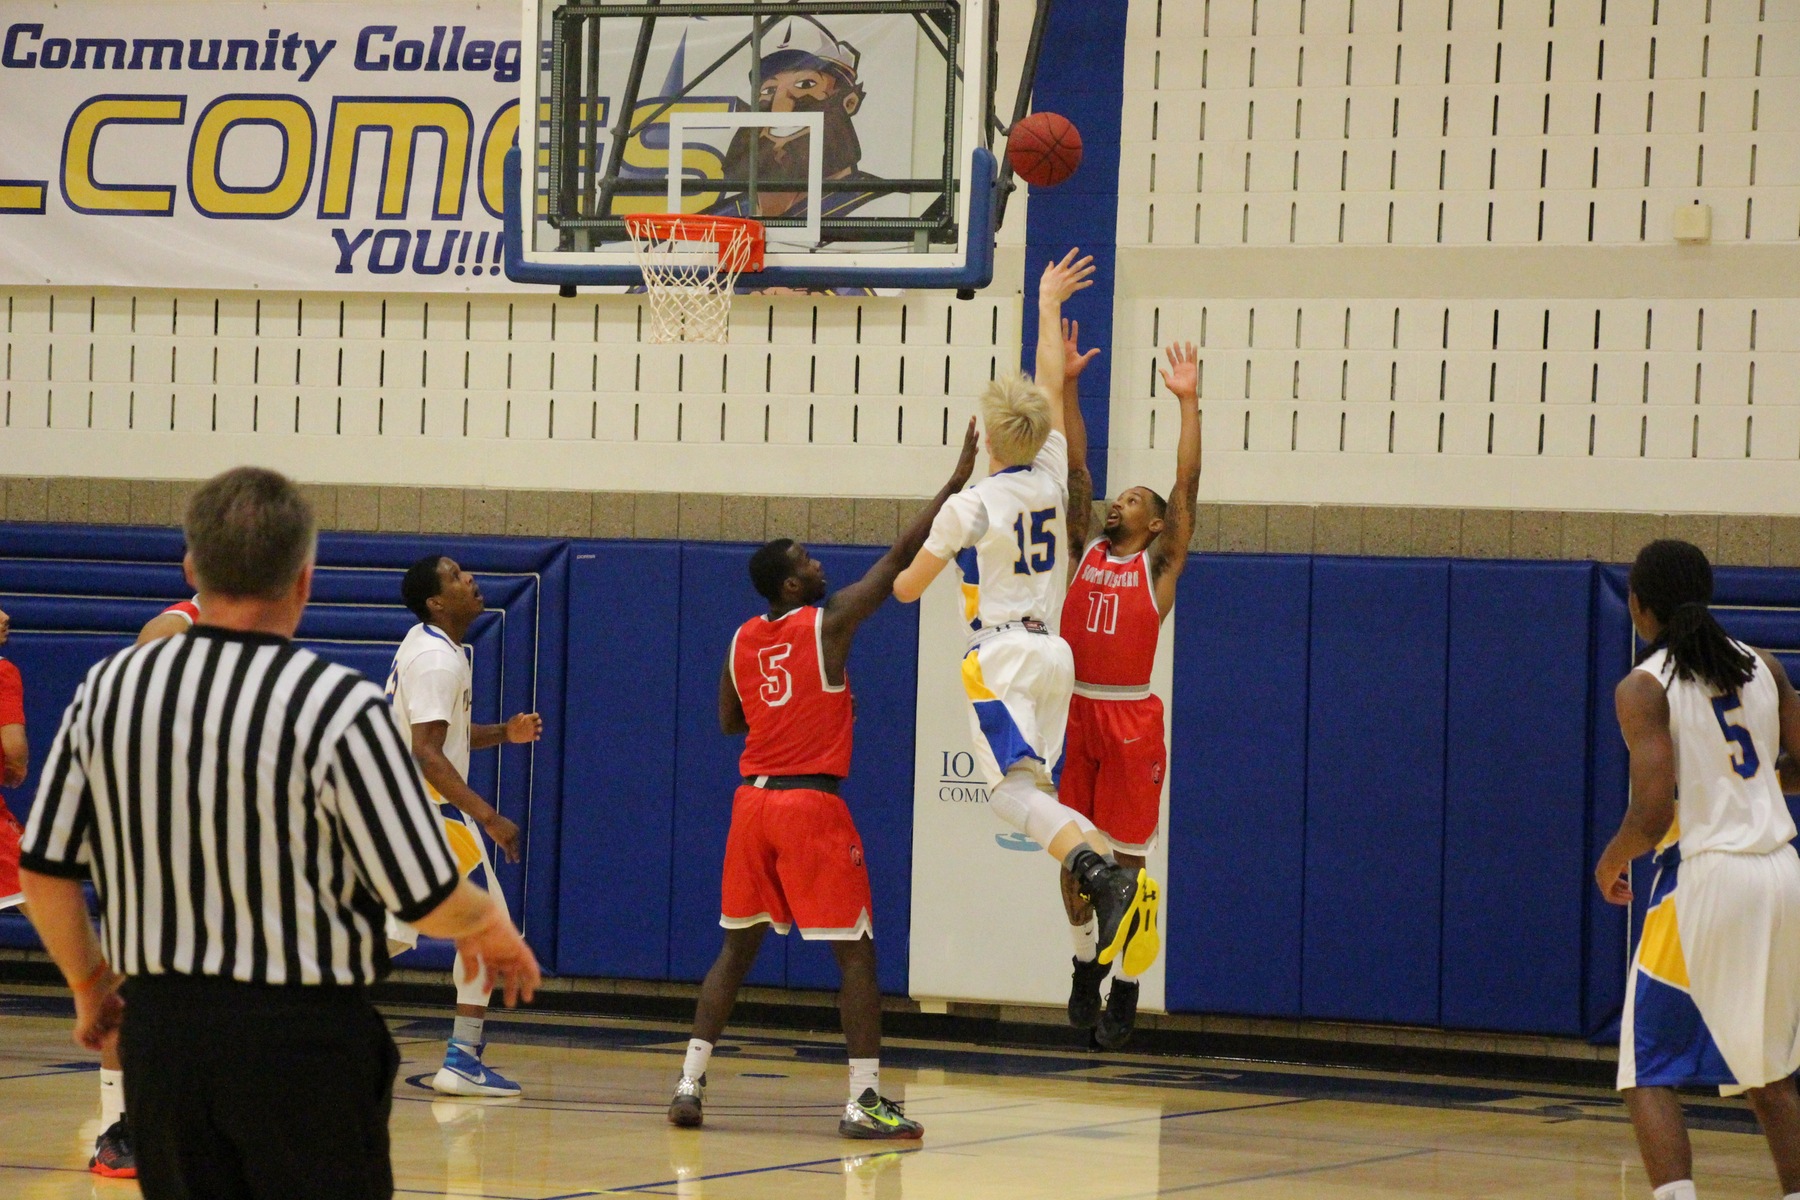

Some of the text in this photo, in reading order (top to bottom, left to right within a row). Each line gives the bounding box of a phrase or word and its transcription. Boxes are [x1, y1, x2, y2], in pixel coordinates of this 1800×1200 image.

[1, 23, 337, 82] Community
[331, 227, 505, 277] YOU!!!
[1013, 505, 1057, 576] 15
[1086, 591, 1119, 635] 11
[757, 642, 793, 707] 5
[1709, 690, 1760, 780] 5
[941, 751, 975, 778] IO
[938, 786, 994, 803] COMM
